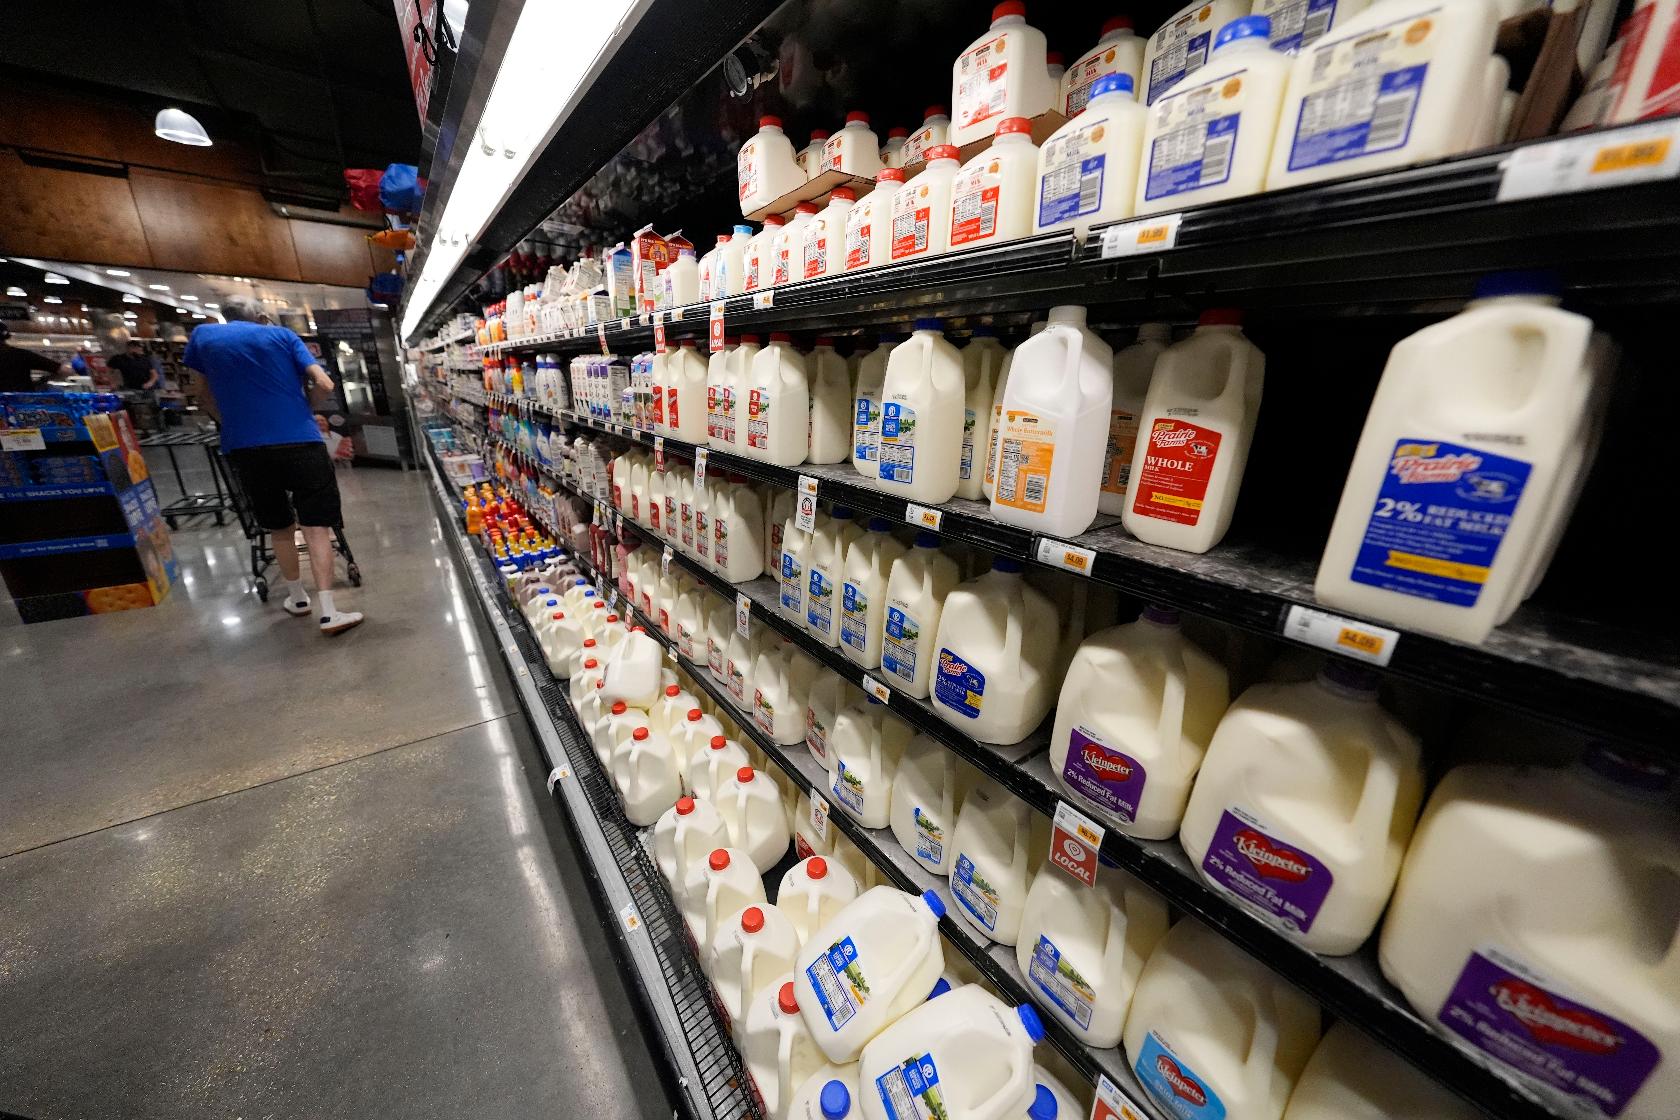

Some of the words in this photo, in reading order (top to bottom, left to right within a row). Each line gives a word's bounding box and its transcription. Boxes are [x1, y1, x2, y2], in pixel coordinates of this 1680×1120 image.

[1152, 429, 1196, 442] Prairie
[1146, 455, 1194, 472] WHOLE
[1374, 498, 1423, 523] 2%
[1081, 748, 1134, 775] Kleinpeter
[1067, 768, 1078, 781] 2%
[1078, 774, 1109, 796] Reduced
[1106, 789, 1117, 805] Fat
[1117, 797, 1134, 812] Milk
[1054, 852, 1091, 881] LOCAL
[1232, 835, 1314, 877] Kleinpeter
[1208, 855, 1225, 872] 2%
[1225, 864, 1267, 897] Reduced
[1265, 887, 1284, 910] Fat
[1283, 898, 1308, 922] Milk
[1155, 1058, 1208, 1104] Kleinpeter
